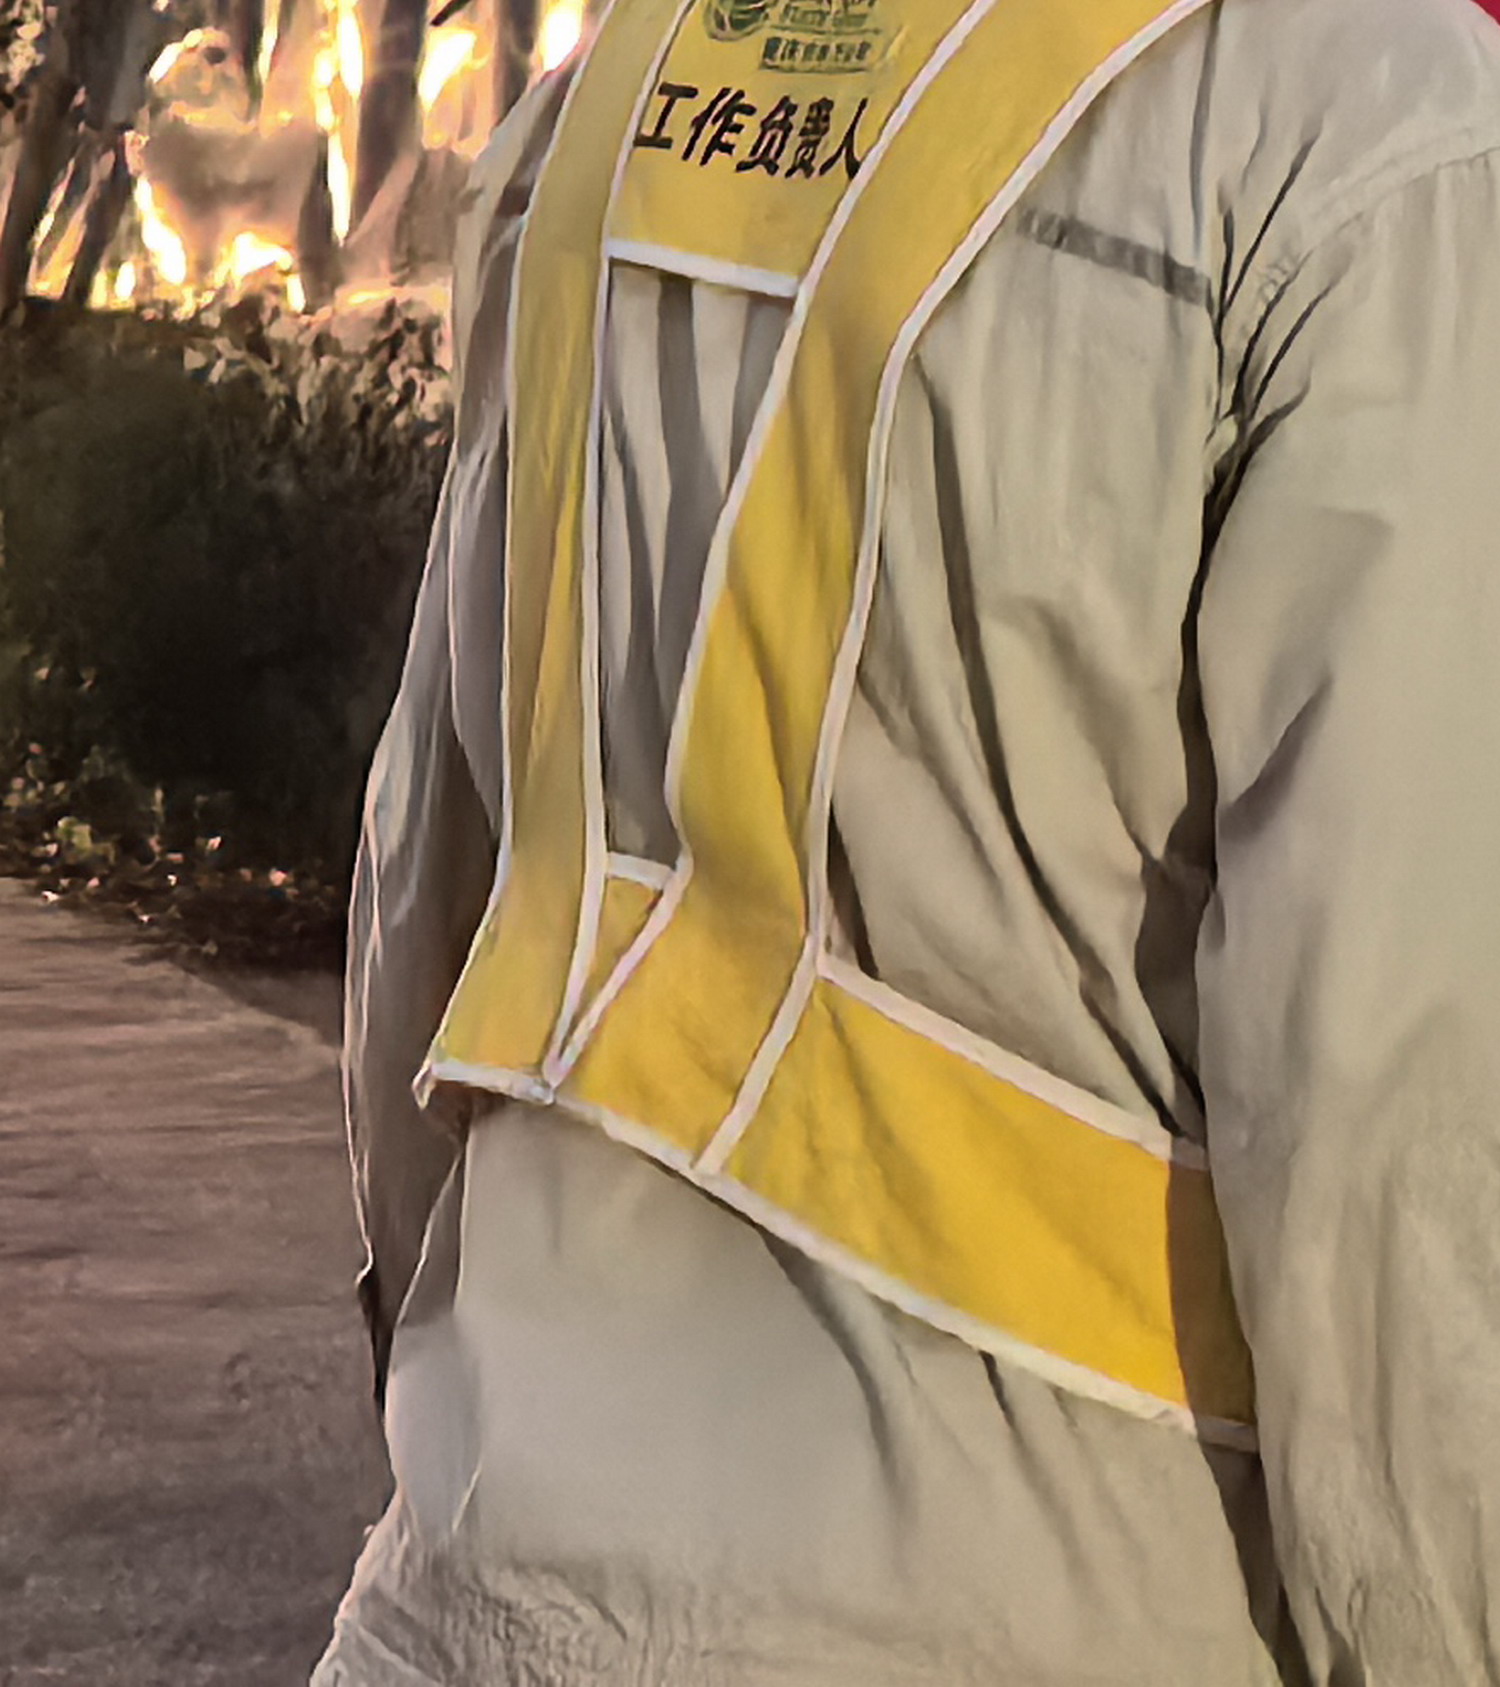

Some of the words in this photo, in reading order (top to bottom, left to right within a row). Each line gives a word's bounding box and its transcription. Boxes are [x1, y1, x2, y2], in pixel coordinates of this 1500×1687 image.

[632, 81, 868, 181] 工作负责人
